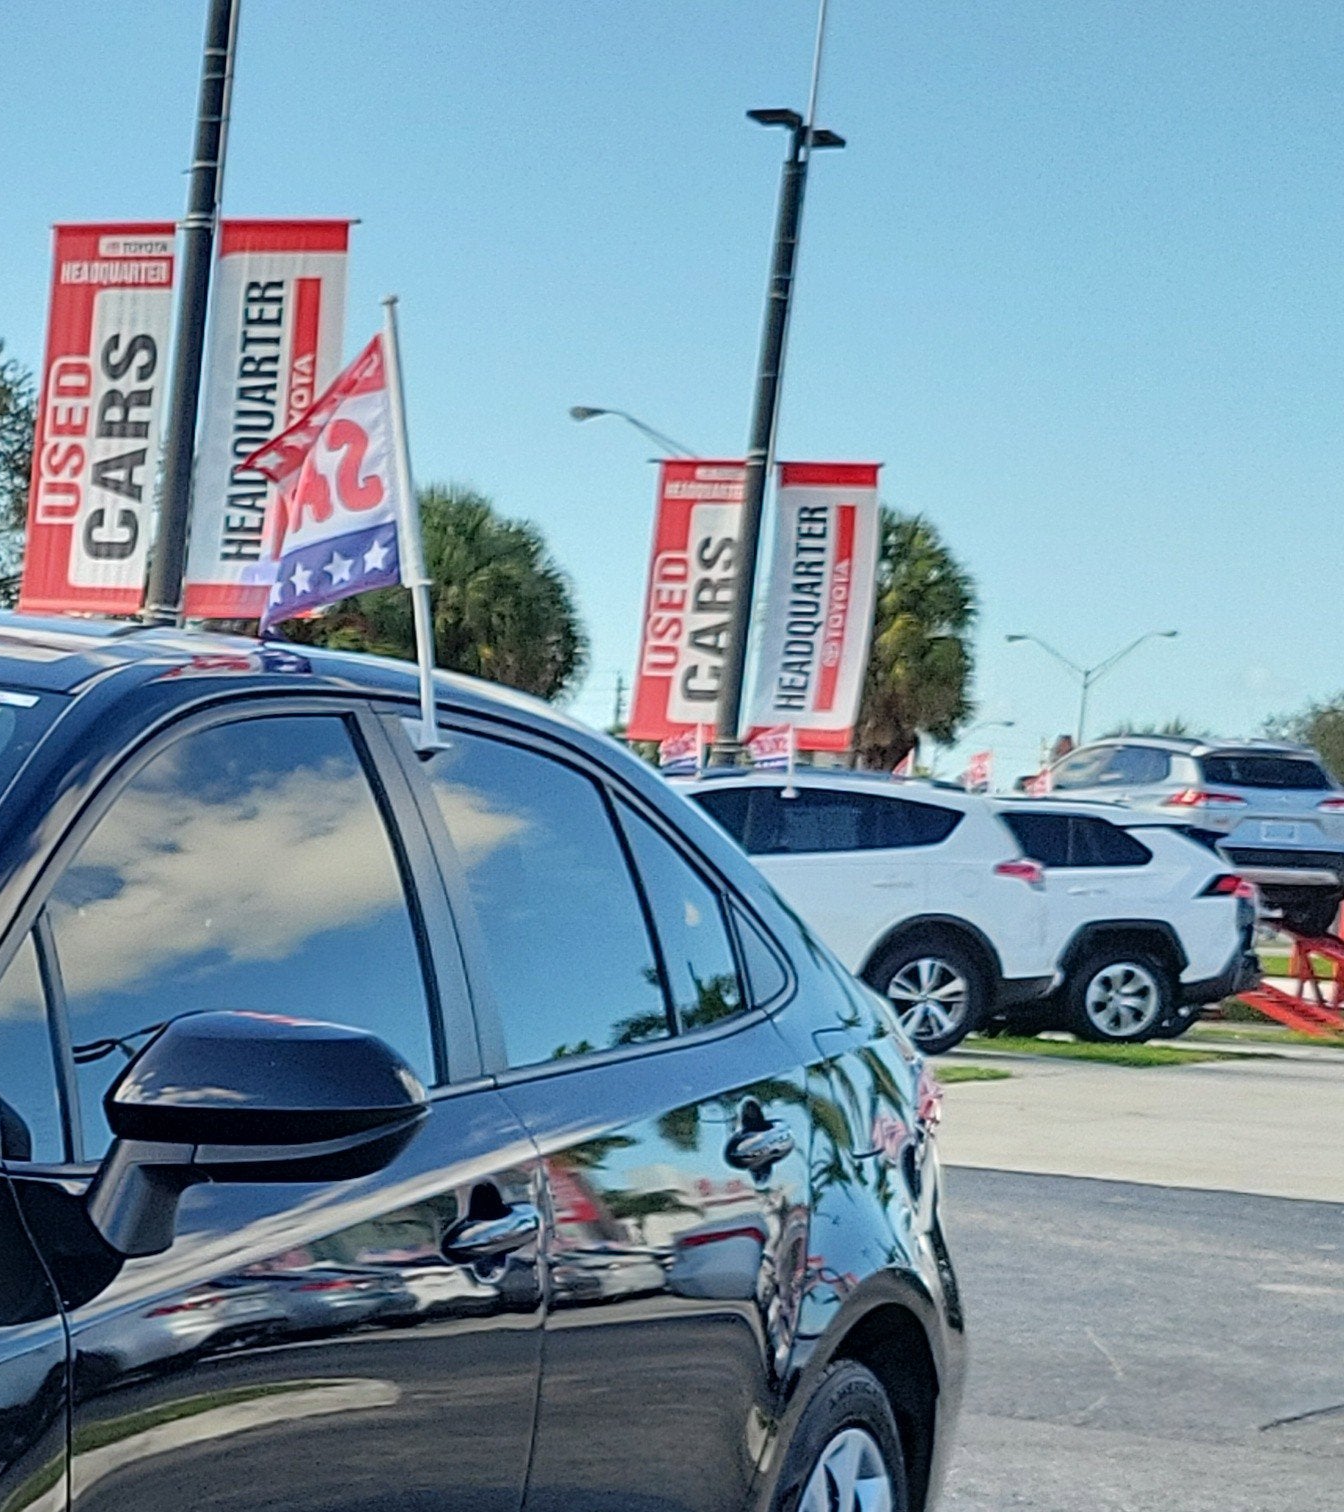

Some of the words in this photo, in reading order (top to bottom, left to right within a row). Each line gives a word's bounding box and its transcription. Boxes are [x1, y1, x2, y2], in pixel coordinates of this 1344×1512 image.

[60, 261, 169, 284] HEADQUARTER
[37, 361, 92, 522] USED
[83, 333, 158, 561] CARS
[644, 556, 687, 675] USED
[681, 536, 739, 703] CARS
[774, 505, 828, 711] HEADQUARTER
[825, 558, 851, 641] TOYOTA
